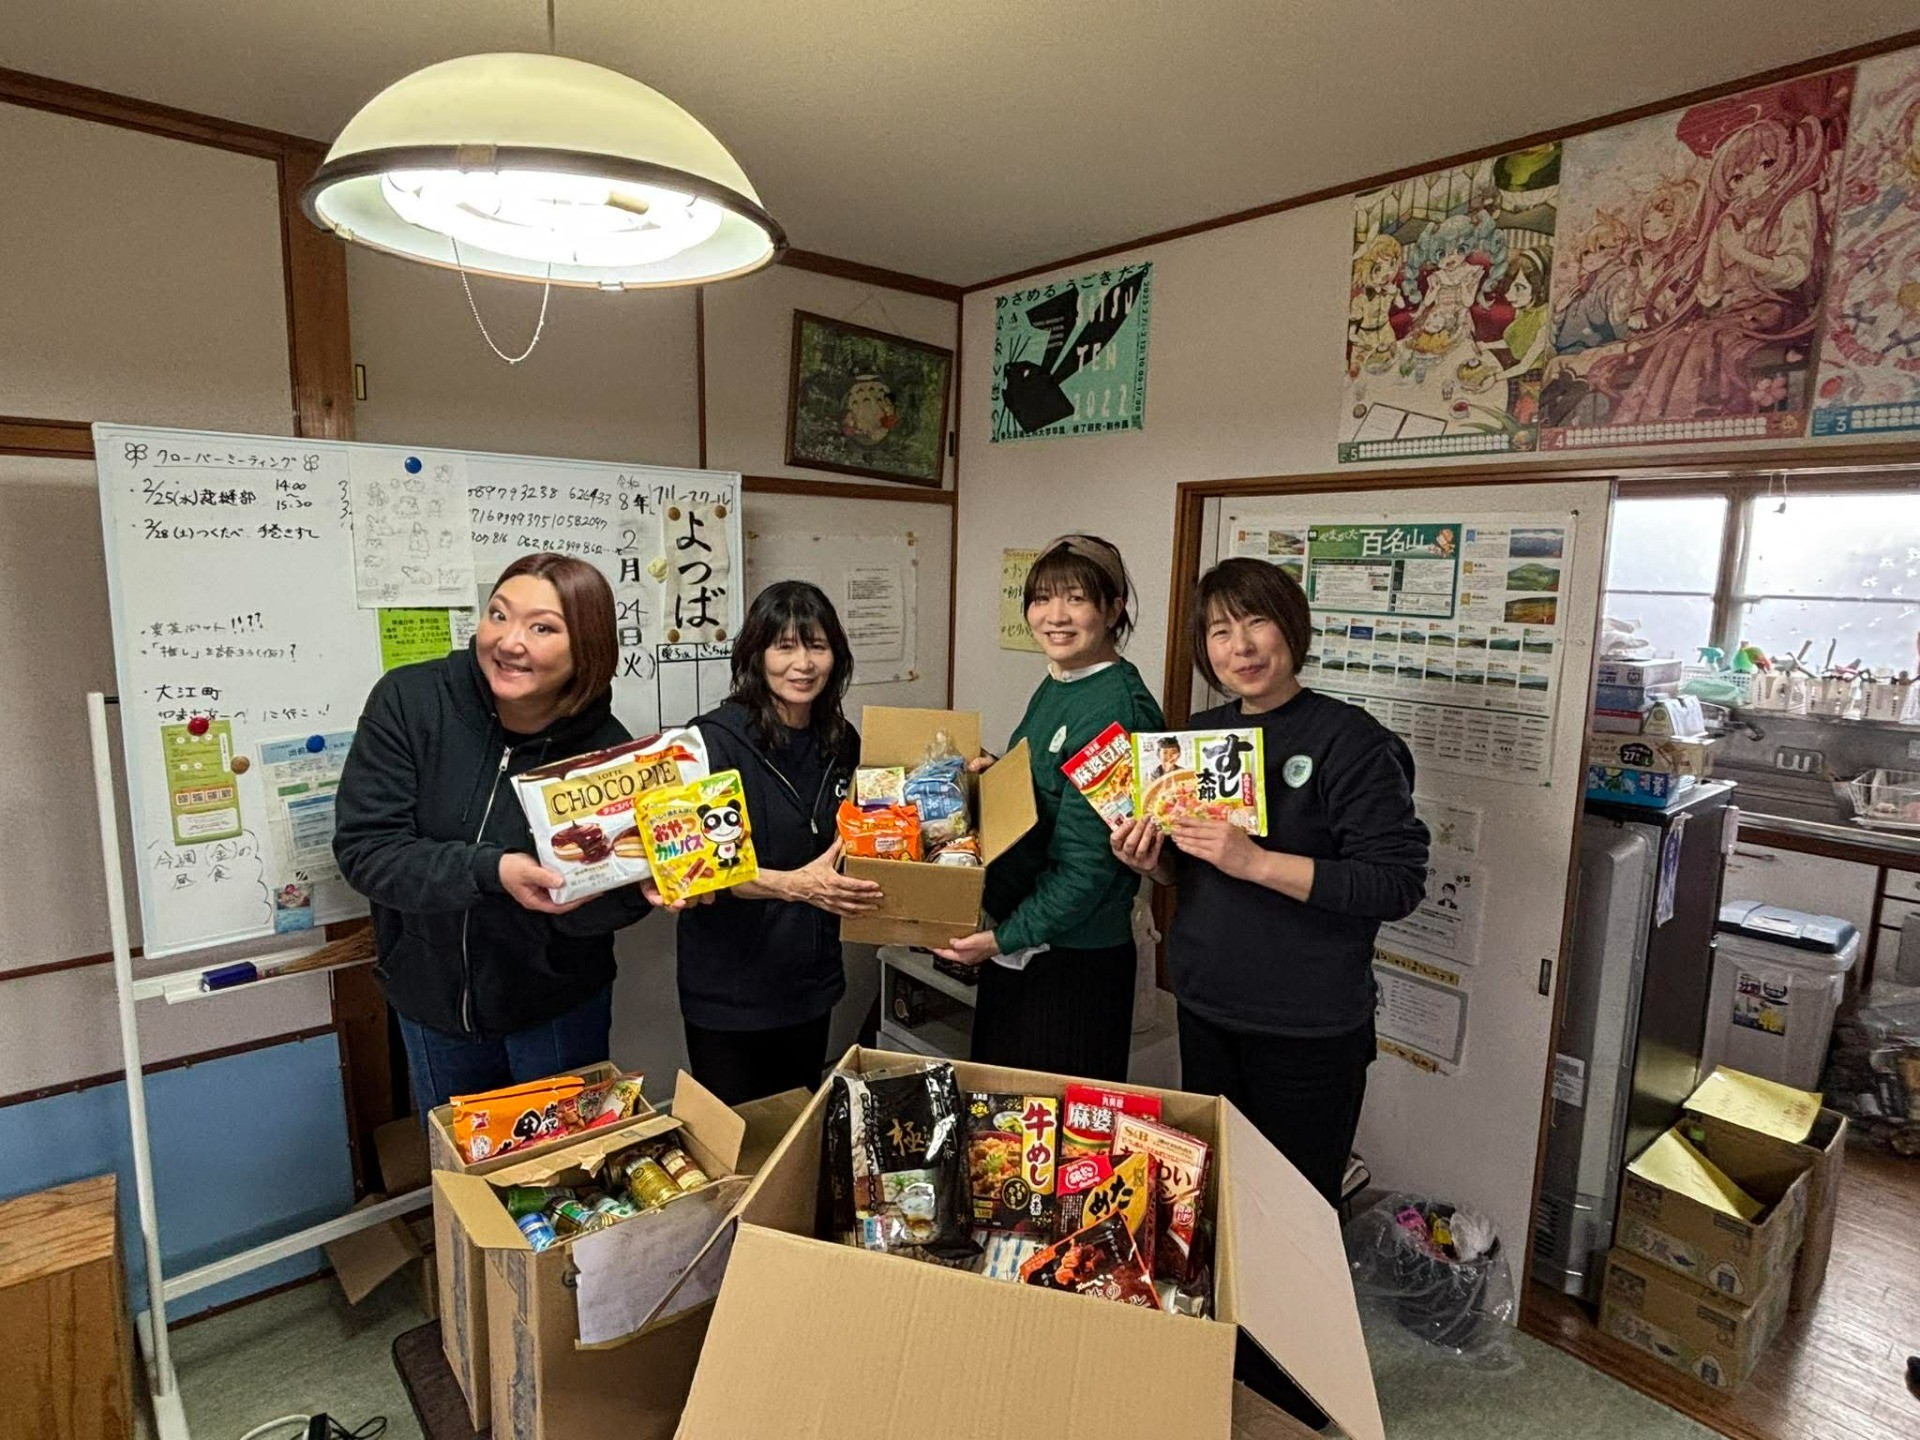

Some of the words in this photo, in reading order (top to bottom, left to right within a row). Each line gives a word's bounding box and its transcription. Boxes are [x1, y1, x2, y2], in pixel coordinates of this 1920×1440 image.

[996, 285, 1056, 308] めざめる
[1066, 261, 1153, 289] うごきだす
[1077, 342, 1116, 373] TEN
[1073, 383, 1128, 421] 2022
[1835, 415, 1847, 432] 3
[1350, 448, 1358, 460] 5
[1554, 433, 1564, 448] 4
[157, 449, 297, 469] クローバーミーティング
[1360, 527, 1425, 557] 百名山
[674, 510, 727, 630] よつば
[155, 684, 223, 702] 大江町
[598, 768, 623, 781] LOTTE
[1070, 733, 1132, 787] 麻婆豆腐
[1202, 733, 1254, 798] すし
[551, 775, 636, 816] CHOCO
[637, 760, 676, 791] PIE
[1195, 767, 1217, 803] 太郎
[653, 817, 697, 843] おやつ
[654, 834, 705, 861] カルパス
[886, 1117, 926, 1158] 極
[1021, 1102, 1055, 1187] 牛めし
[1124, 1125, 1149, 1142] S&B
